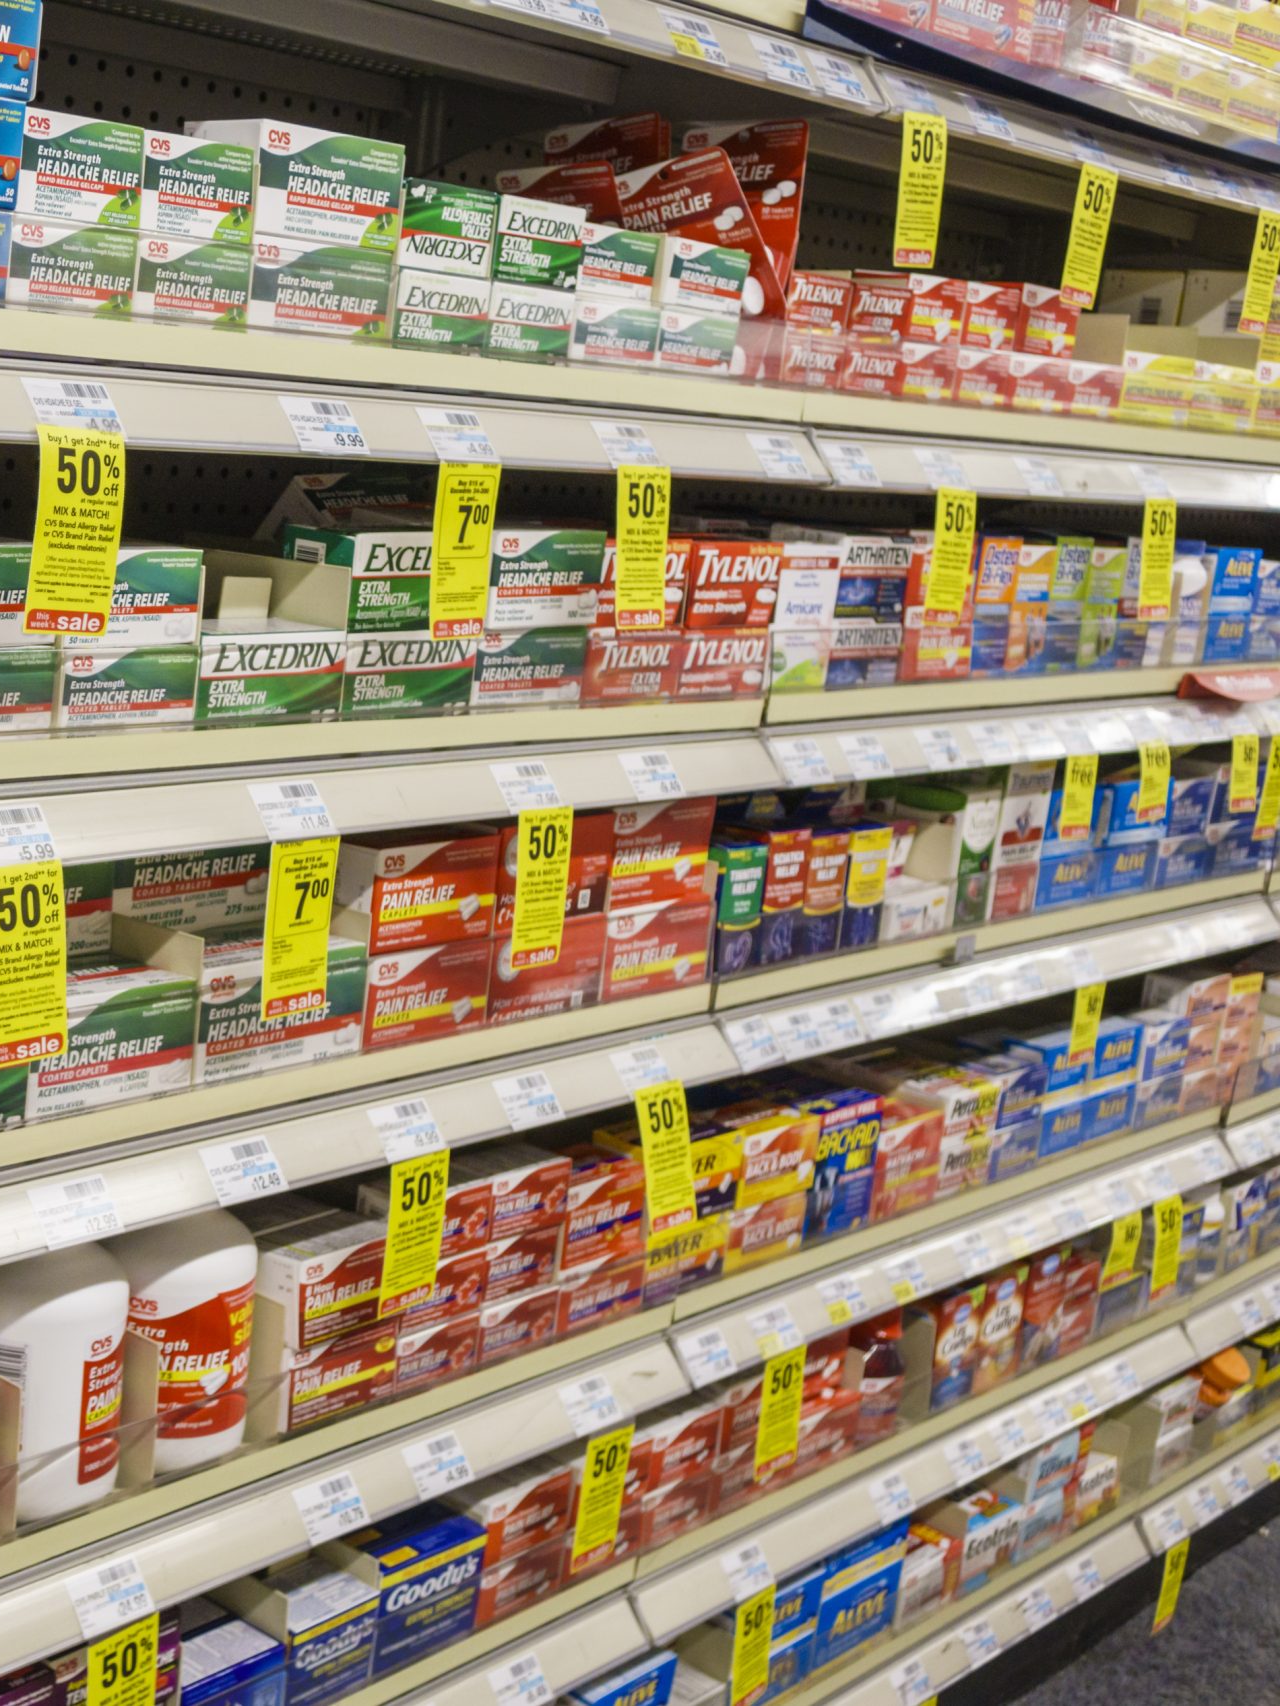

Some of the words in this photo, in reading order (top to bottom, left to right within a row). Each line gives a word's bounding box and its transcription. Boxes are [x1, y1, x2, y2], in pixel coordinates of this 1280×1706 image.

[37, 144, 64, 160] Extra
[66, 148, 102, 165] Strength
[37, 157, 101, 182] HEADACHE
[102, 167, 139, 188] RELIEF
[442, 206, 493, 225] STRENGTH
[456, 219, 490, 241] EXTRA
[507, 210, 580, 241] EXCEDRIN
[406, 234, 486, 266] EXCEDRIN
[405, 286, 486, 315] EXCEDRIN
[792, 277, 844, 306] TYLENOL
[698, 549, 780, 583] TYLENOL
[847, 545, 911, 566] ARTHRITEN
[1226, 558, 1255, 577] ALEVE
[57, 613, 100, 632] sale
[213, 643, 339, 672] EXCEDRIN
[135, 859, 204, 886] HEADACHE
[207, 853, 255, 876] RELIEF
[385, 854, 405, 868] CVS
[382, 888, 415, 909] PAIN
[418, 884, 454, 902] RELIEF
[16, 1036, 60, 1059] sale
[306, 1289, 331, 1309] PAIN
[334, 1278, 375, 1300] RELIEF
[387, 1550, 480, 1612] Goody's
